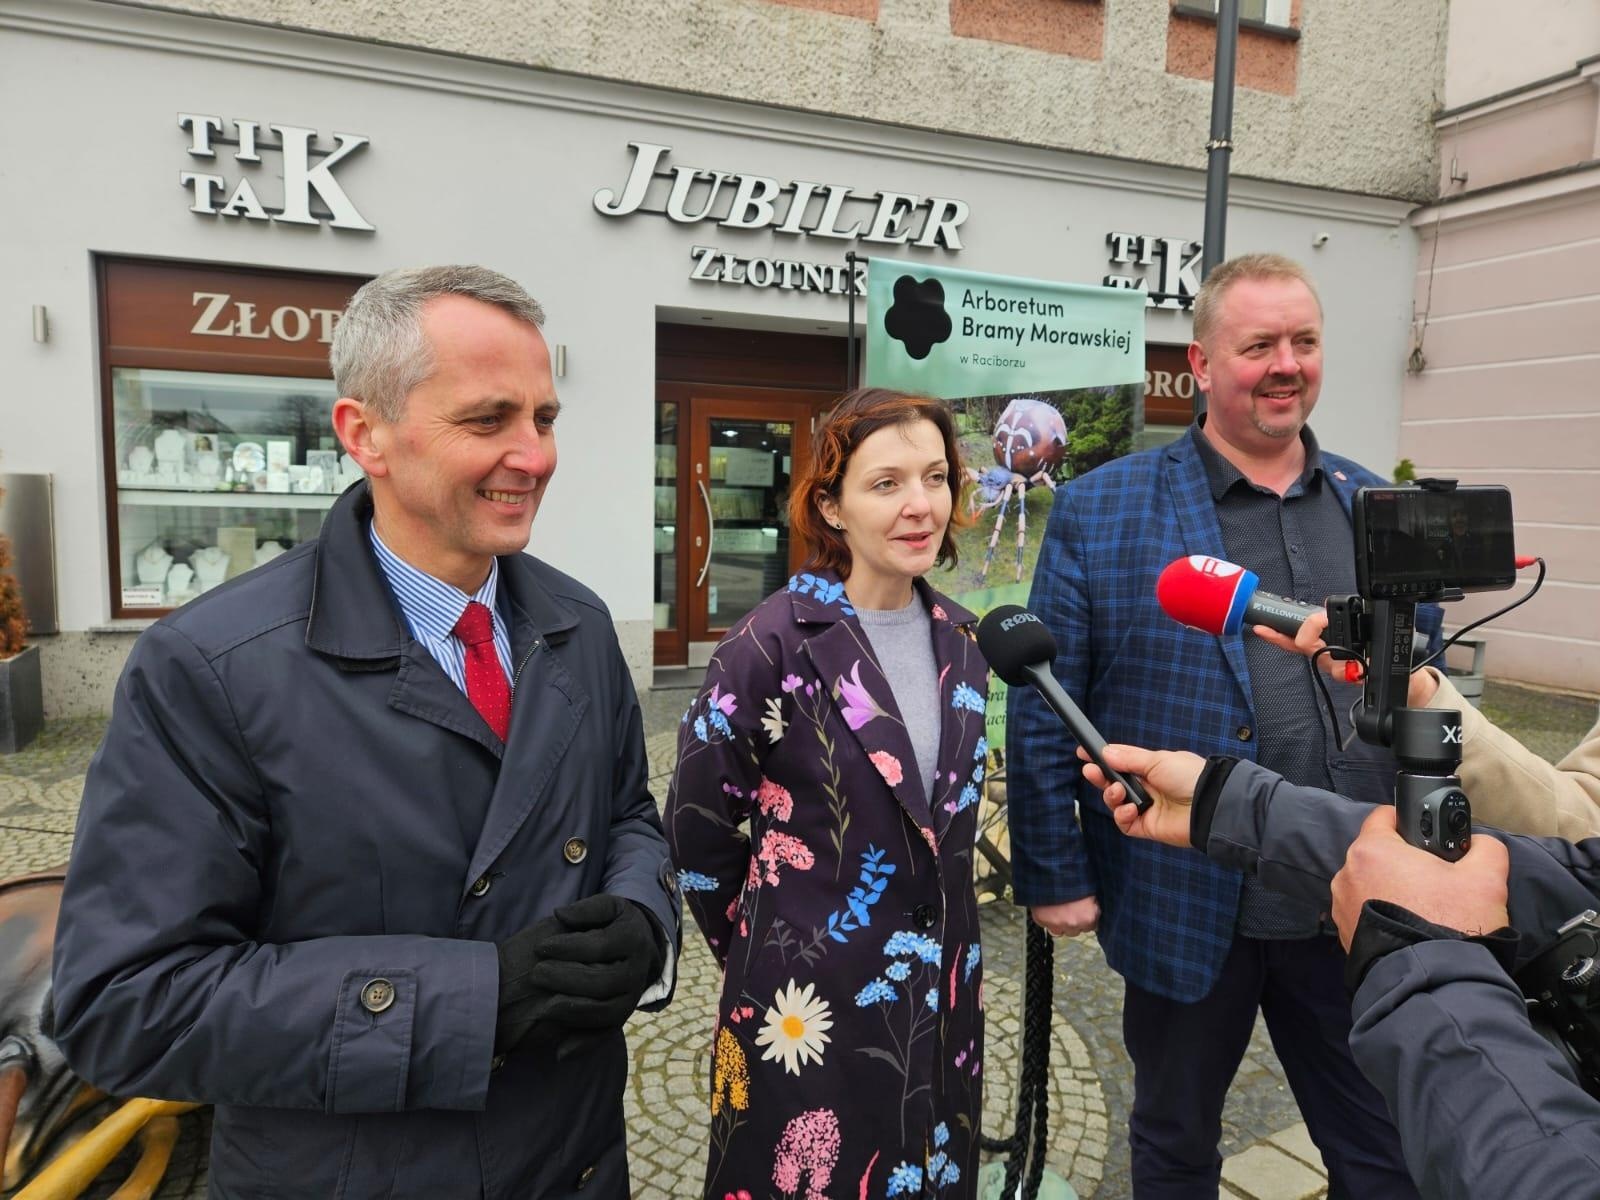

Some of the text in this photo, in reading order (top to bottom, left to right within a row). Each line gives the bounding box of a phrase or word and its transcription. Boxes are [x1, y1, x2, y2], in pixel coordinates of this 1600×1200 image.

[593, 141, 970, 251] JUBILER
[962, 289, 1064, 317] Arboretum
[962, 316, 1131, 354] Bramy Morawskiej
[960, 353, 1026, 368] w Raciborzu
[1000, 613, 1043, 632] RØD
